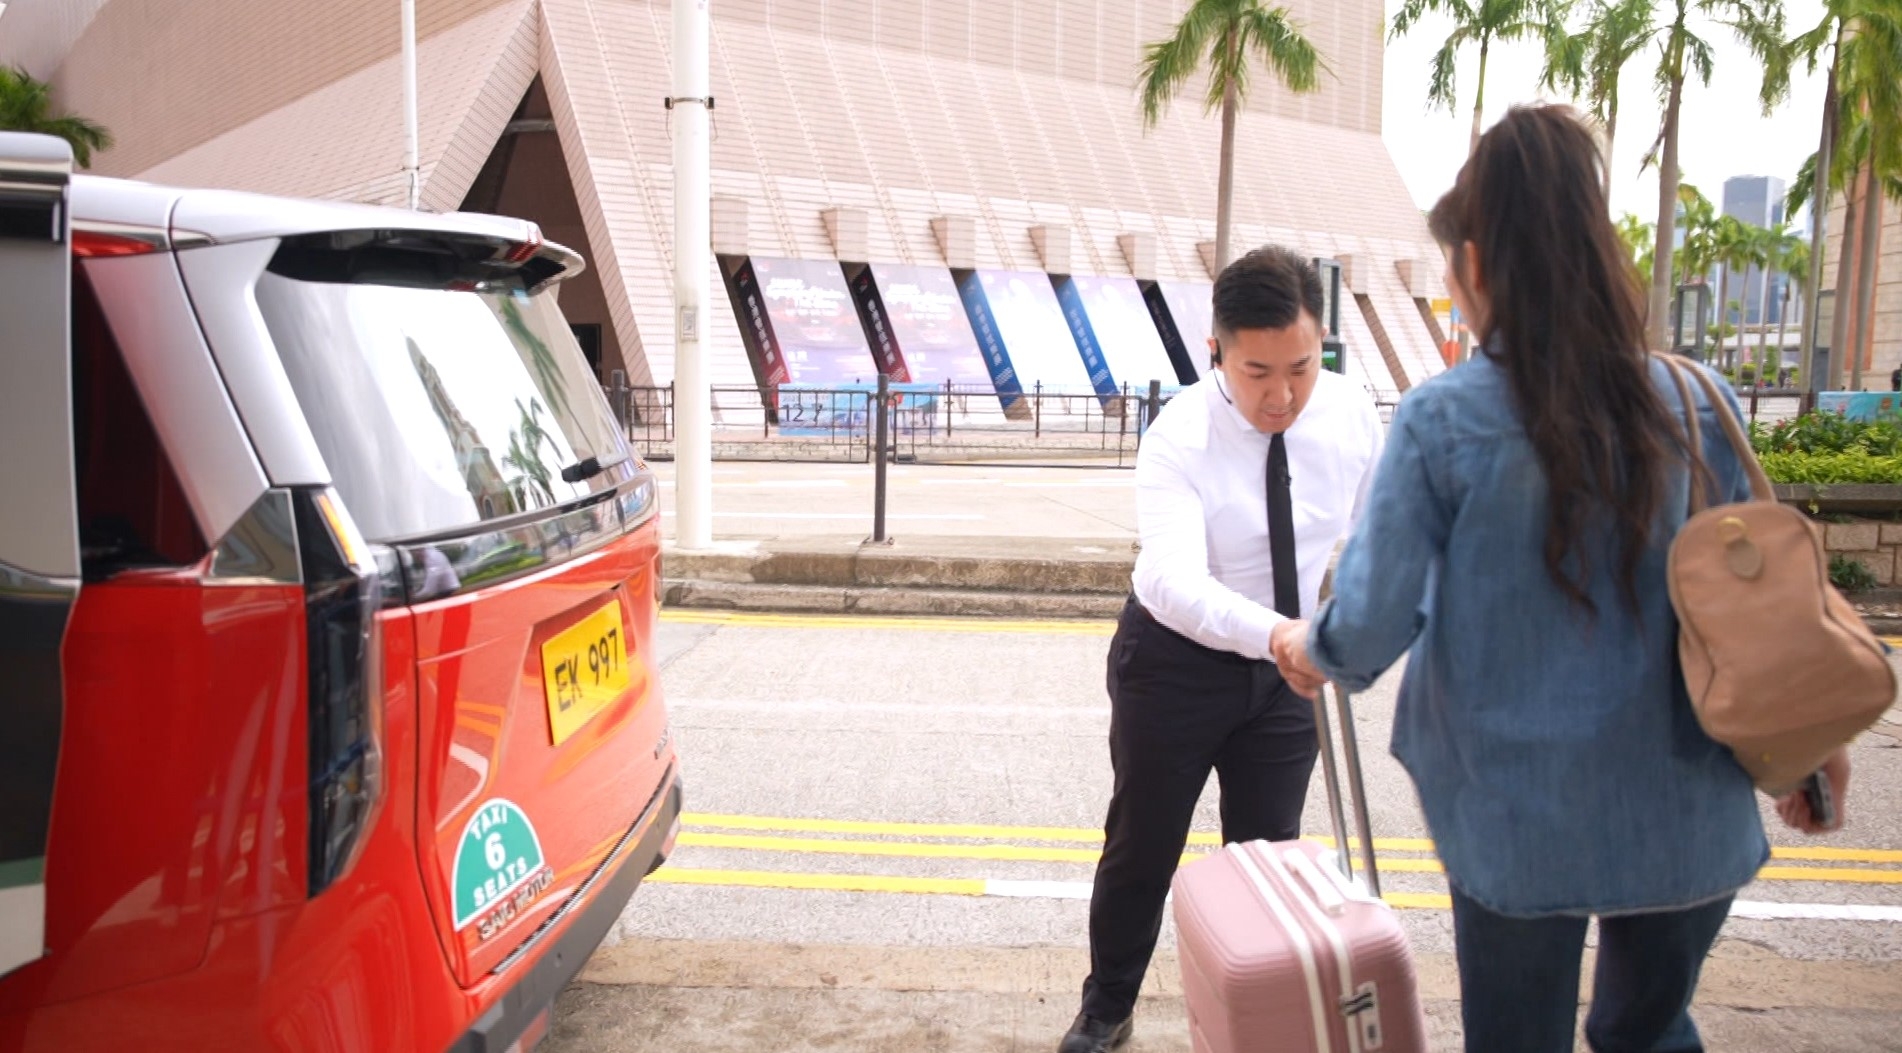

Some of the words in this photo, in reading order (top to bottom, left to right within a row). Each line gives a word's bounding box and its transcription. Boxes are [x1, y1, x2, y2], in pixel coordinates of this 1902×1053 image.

[555, 652, 583, 713] EK
[588, 627, 618, 687] 997
[470, 805, 508, 840] TAXI
[484, 832, 506, 870] 6
[473, 857, 527, 907] SEATS
